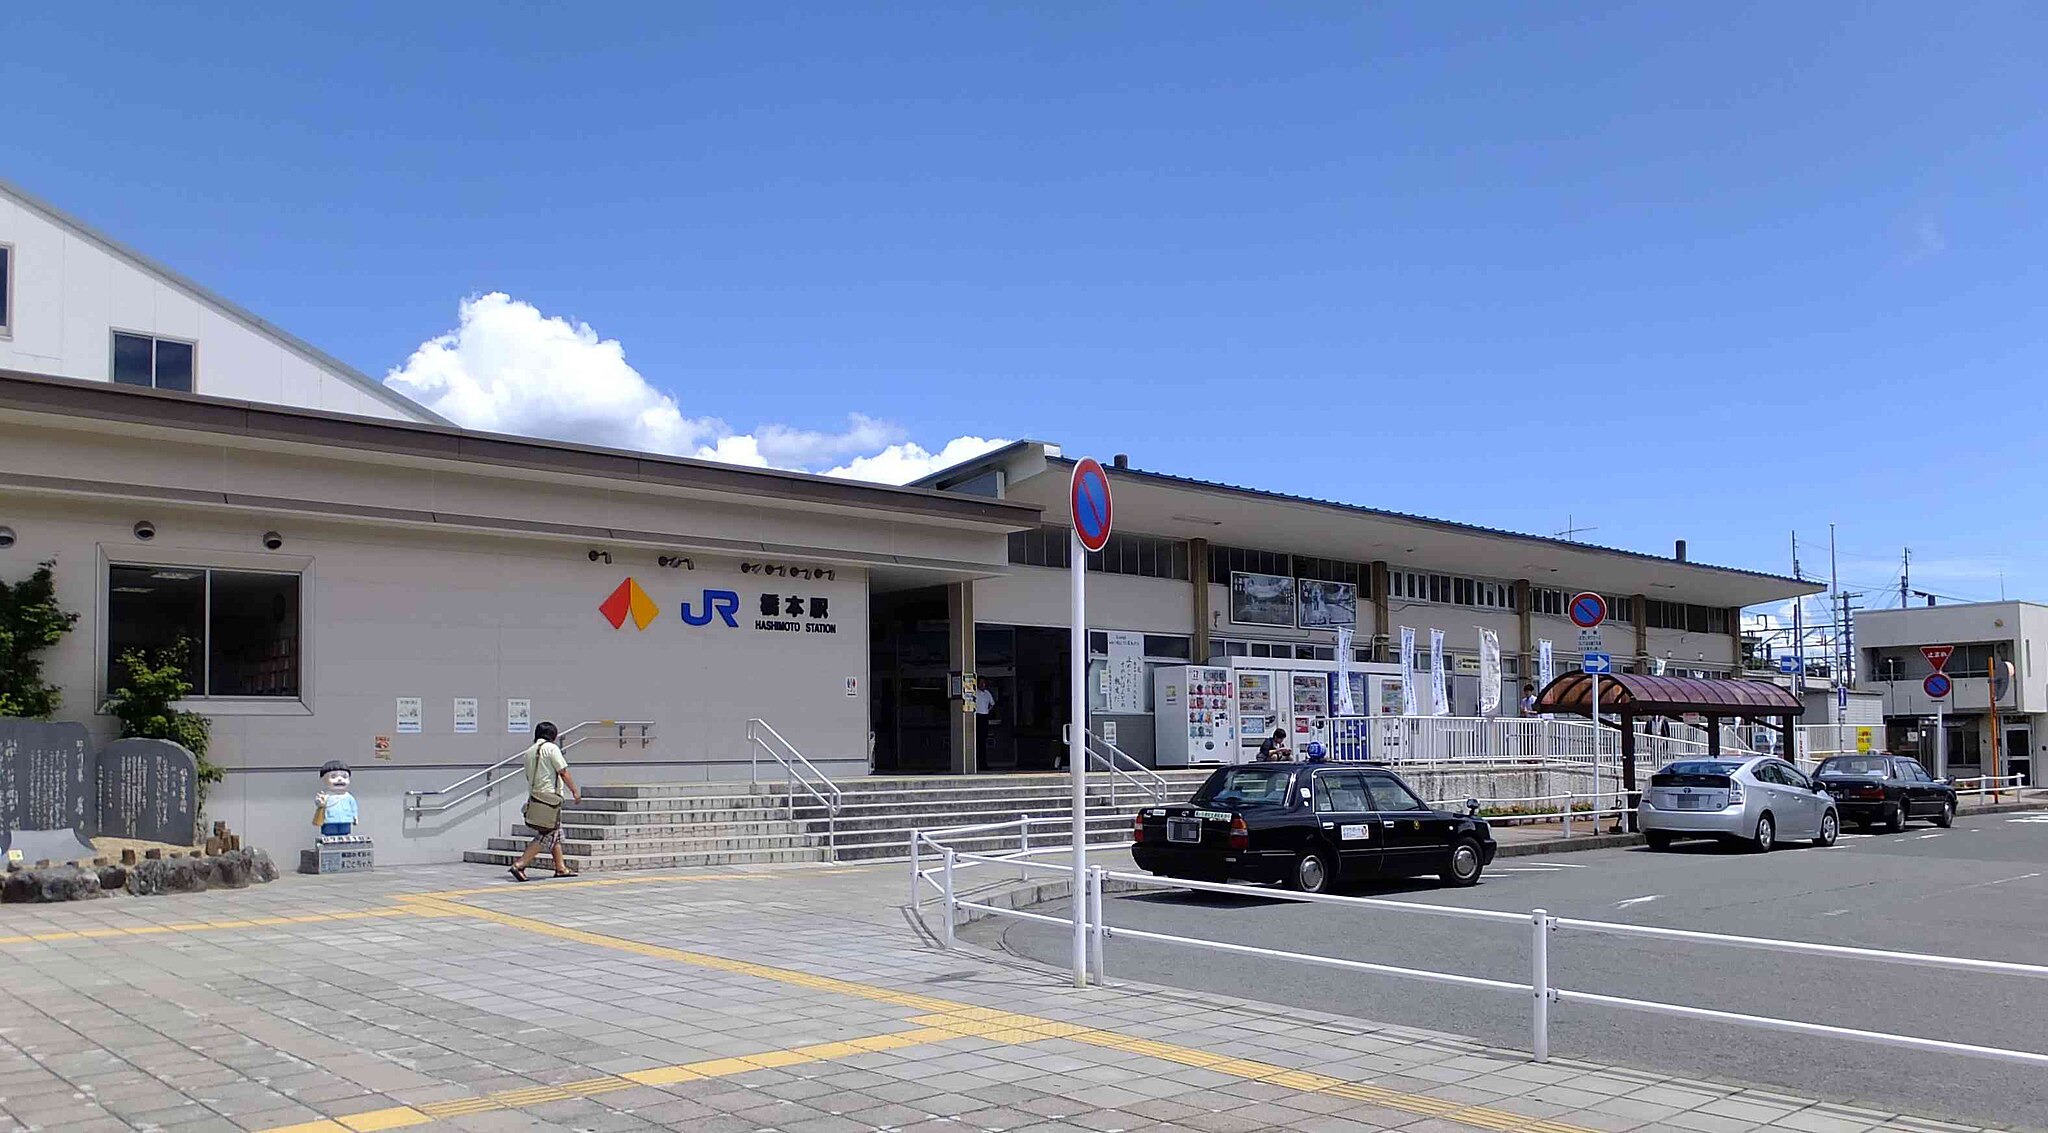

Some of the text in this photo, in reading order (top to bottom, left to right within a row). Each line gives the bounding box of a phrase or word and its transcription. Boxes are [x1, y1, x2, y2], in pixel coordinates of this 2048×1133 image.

[681, 589, 739, 627] JR
[760, 593, 829, 619] 橋本駅
[755, 620, 836, 634] HASHIMOTO STATION
